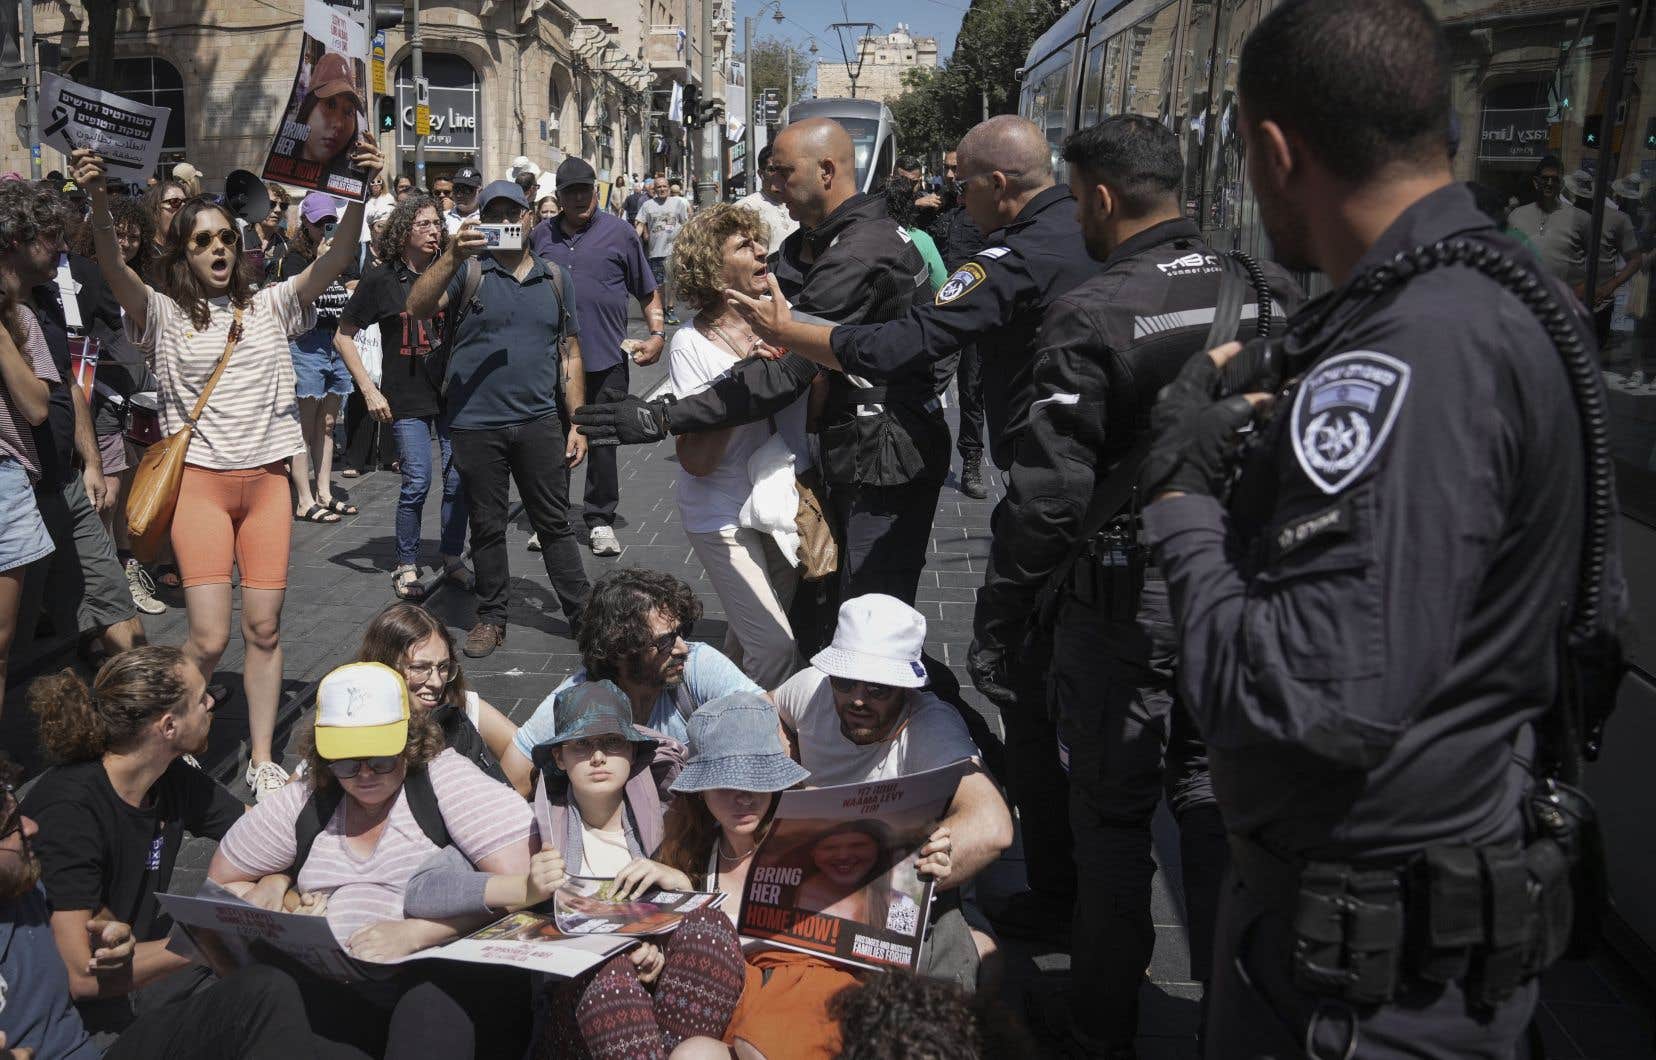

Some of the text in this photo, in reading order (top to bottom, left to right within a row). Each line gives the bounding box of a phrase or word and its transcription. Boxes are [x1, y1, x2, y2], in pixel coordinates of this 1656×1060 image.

[62, 93, 152, 126] סטודנטים דורשים
[402, 106, 445, 131] Czy
[448, 107, 476, 129] Line
[77, 113, 149, 138] עסקת חטופים
[281, 120, 311, 142] BRING
[274, 136, 296, 156] HER
[753, 866, 802, 886] BRING
[749, 882, 781, 905] HER
[745, 904, 840, 945] HOME NOW!
[853, 942, 912, 965] FAMILIES FORUM
